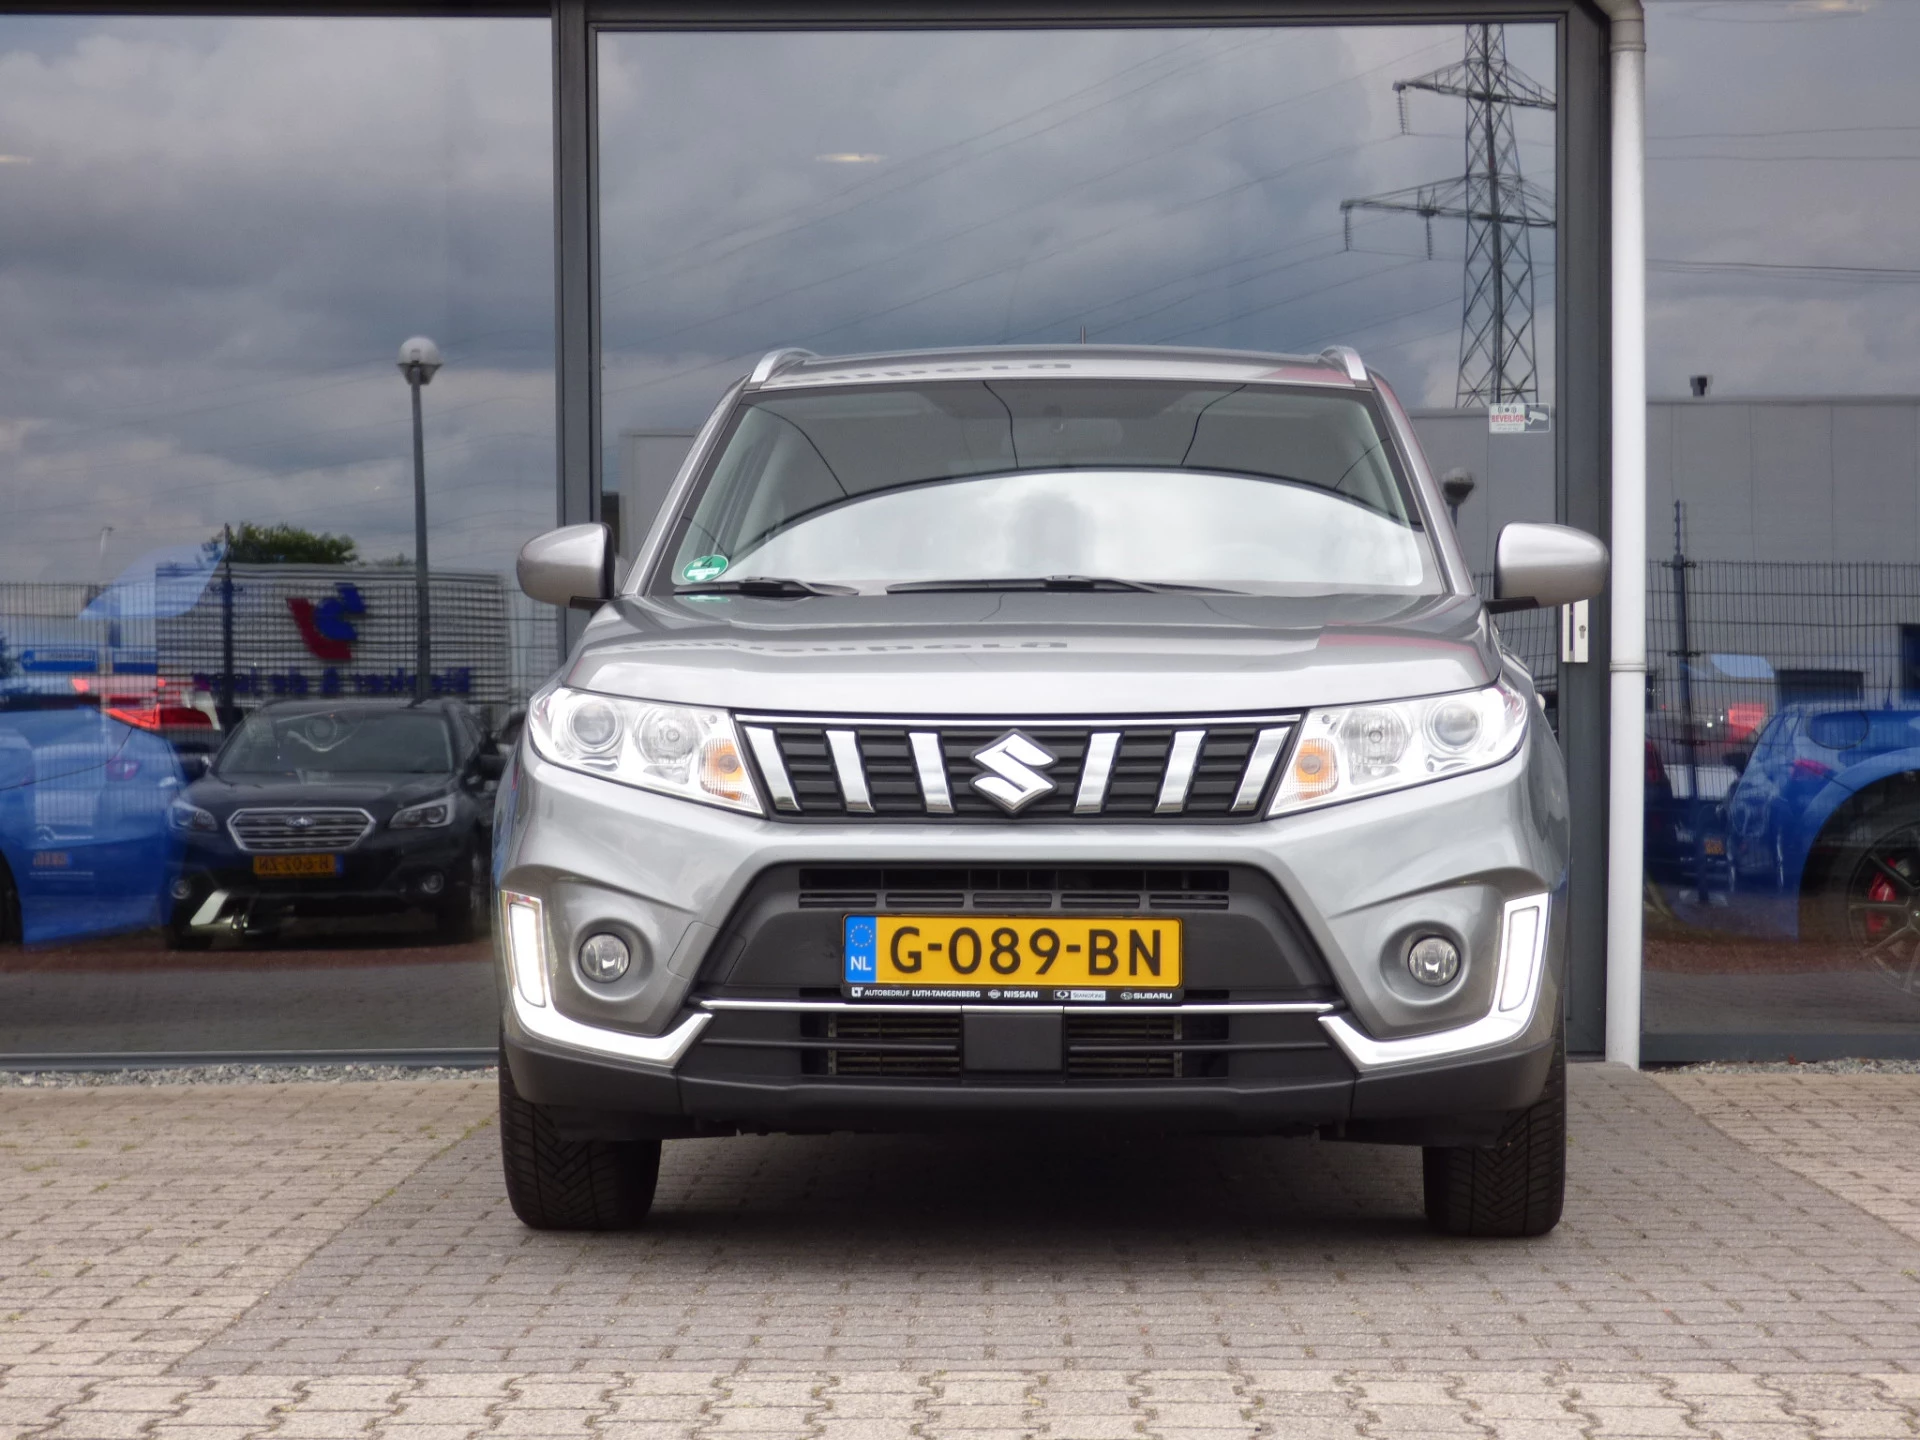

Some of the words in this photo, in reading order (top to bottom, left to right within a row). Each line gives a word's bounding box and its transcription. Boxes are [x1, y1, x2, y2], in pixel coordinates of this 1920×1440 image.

[701, 556, 713, 568] 4
[890, 926, 1160, 977] G-089-BN
[850, 957, 871, 971] NL
[864, 989, 910, 997] AUTOBEDRIJF
[912, 990, 981, 998] LUTH-TANGENBERG
[1004, 990, 1038, 998] NISSAN
[1133, 992, 1173, 1000] SUBARU
